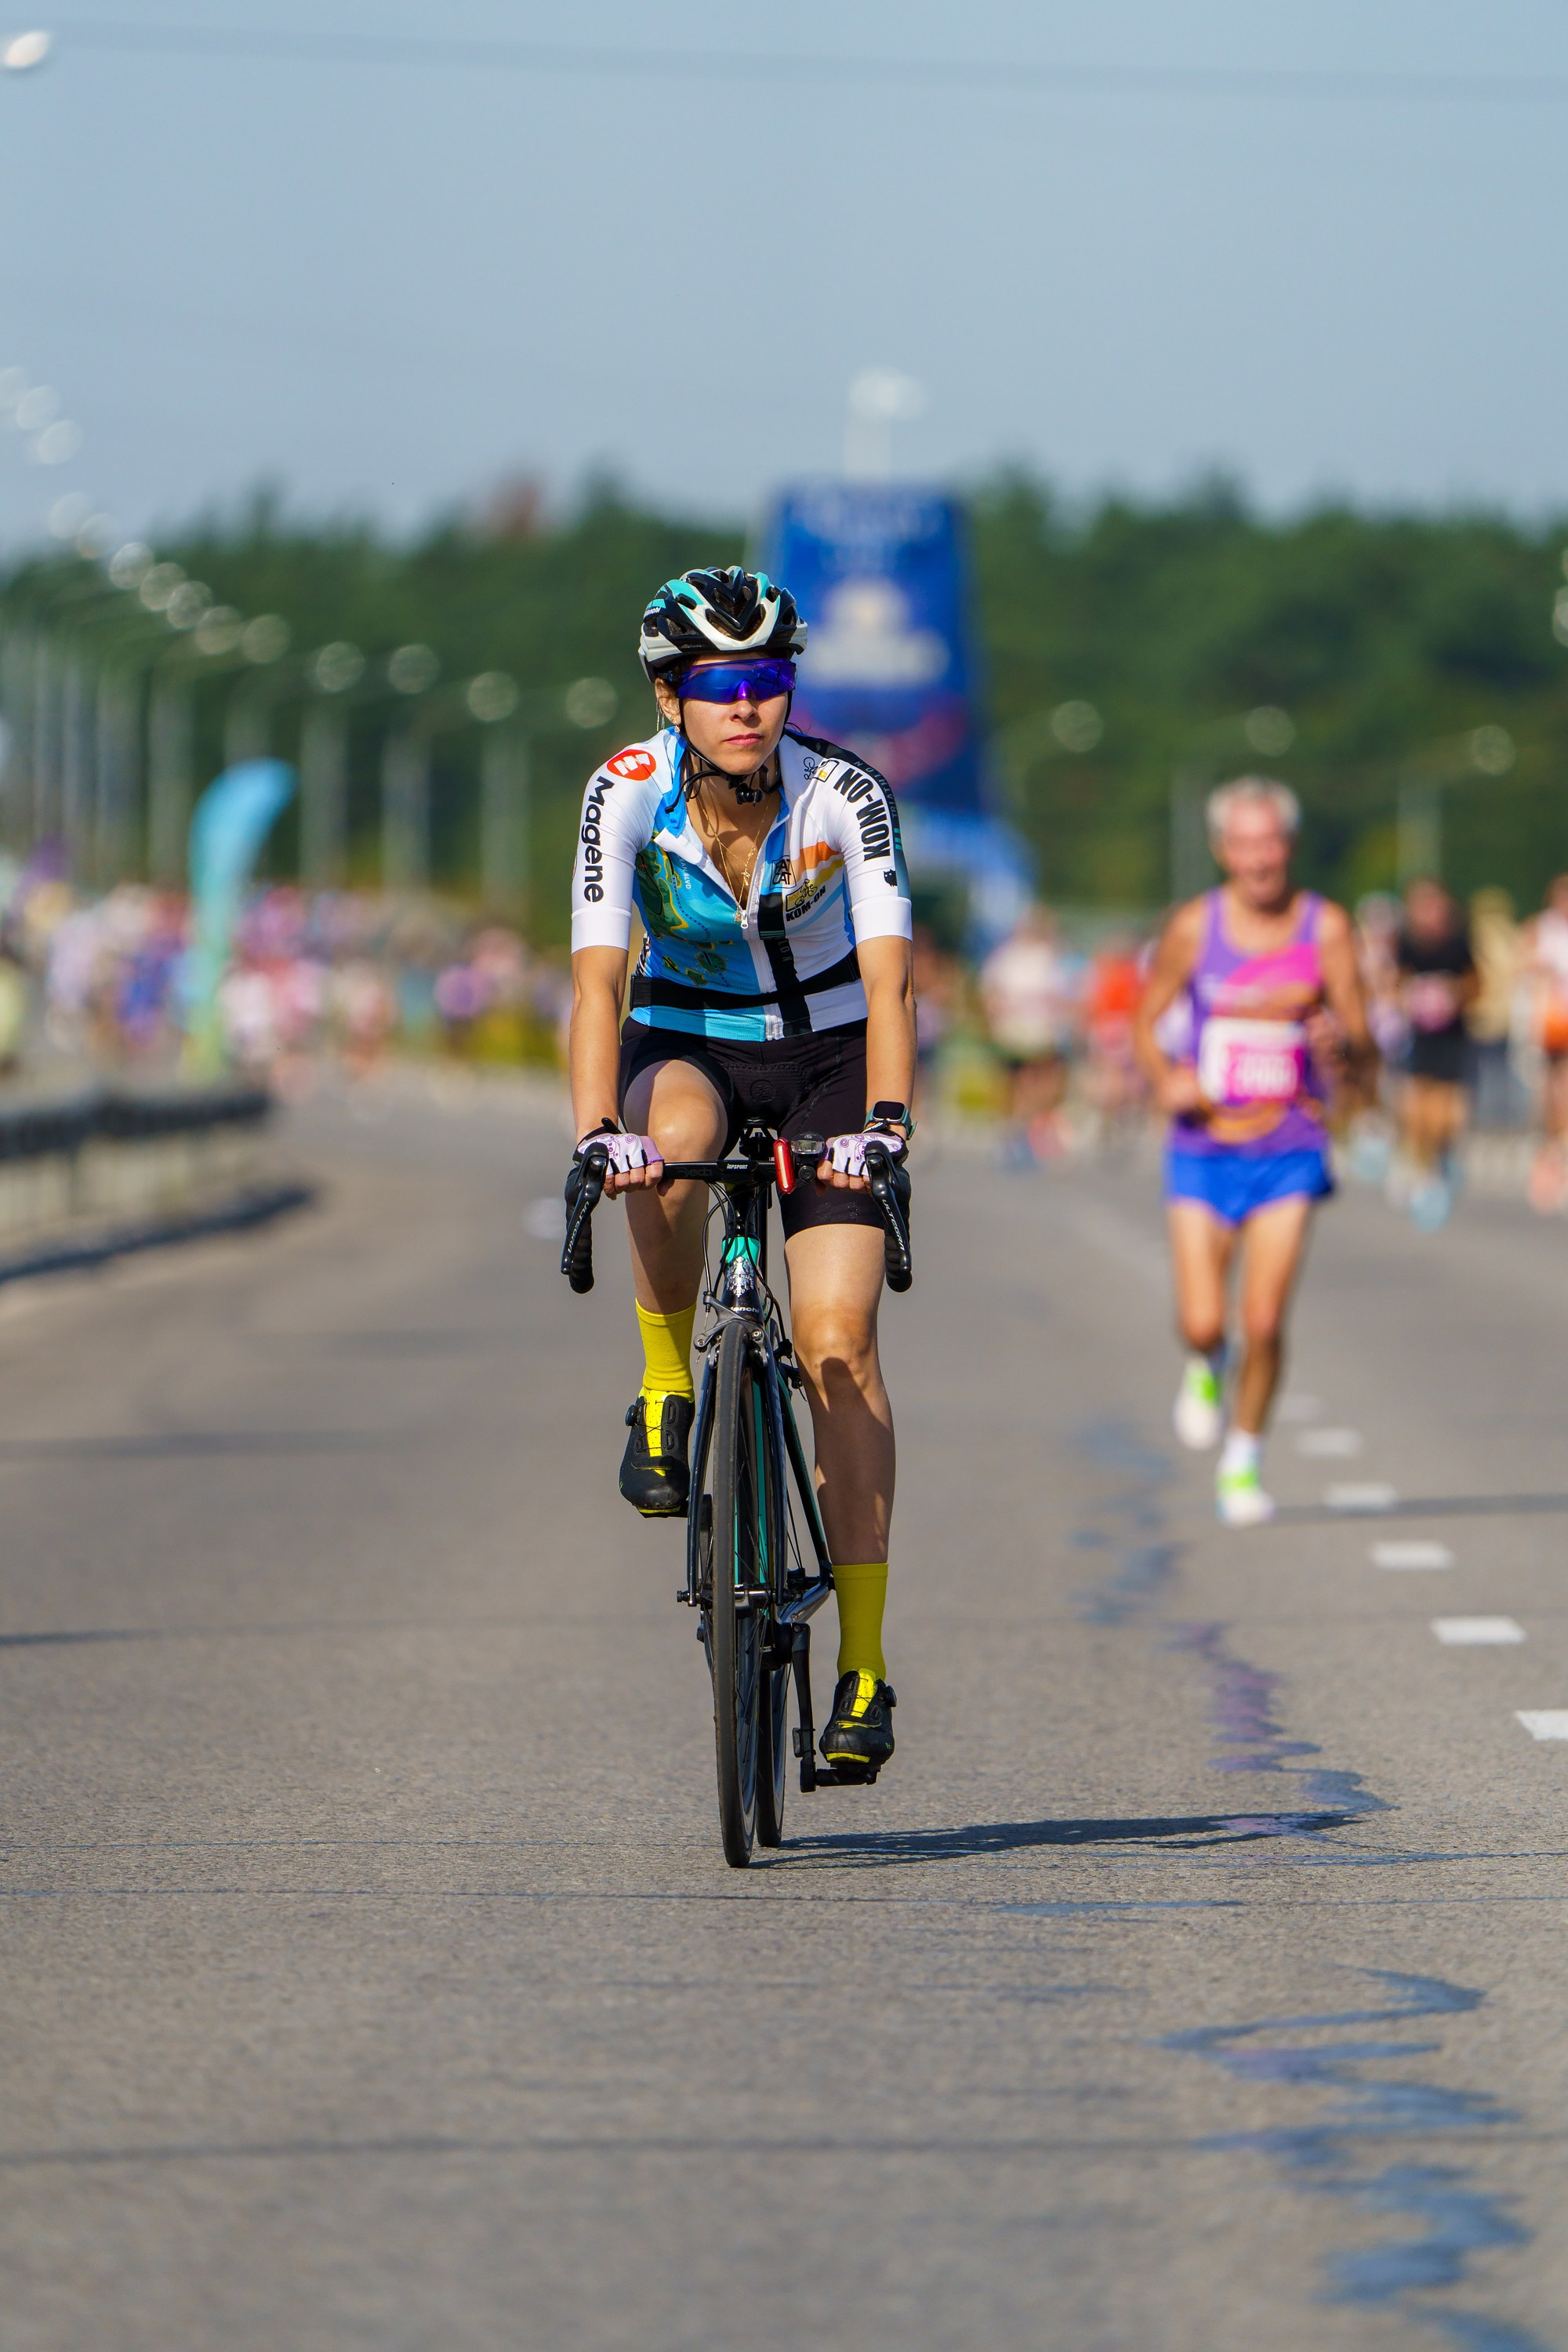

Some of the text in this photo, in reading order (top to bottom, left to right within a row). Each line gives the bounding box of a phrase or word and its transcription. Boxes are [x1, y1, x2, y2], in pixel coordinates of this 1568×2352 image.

[833, 768, 891, 862] KOM-ON
[581, 775, 615, 903] Magene
[684, 873, 692, 890] BLVD
[772, 872, 791, 884] CAT
[774, 859, 790, 874] FAT
[785, 884, 826, 922] KOM-ON
[882, 1199, 906, 1251] ULTEGRA
